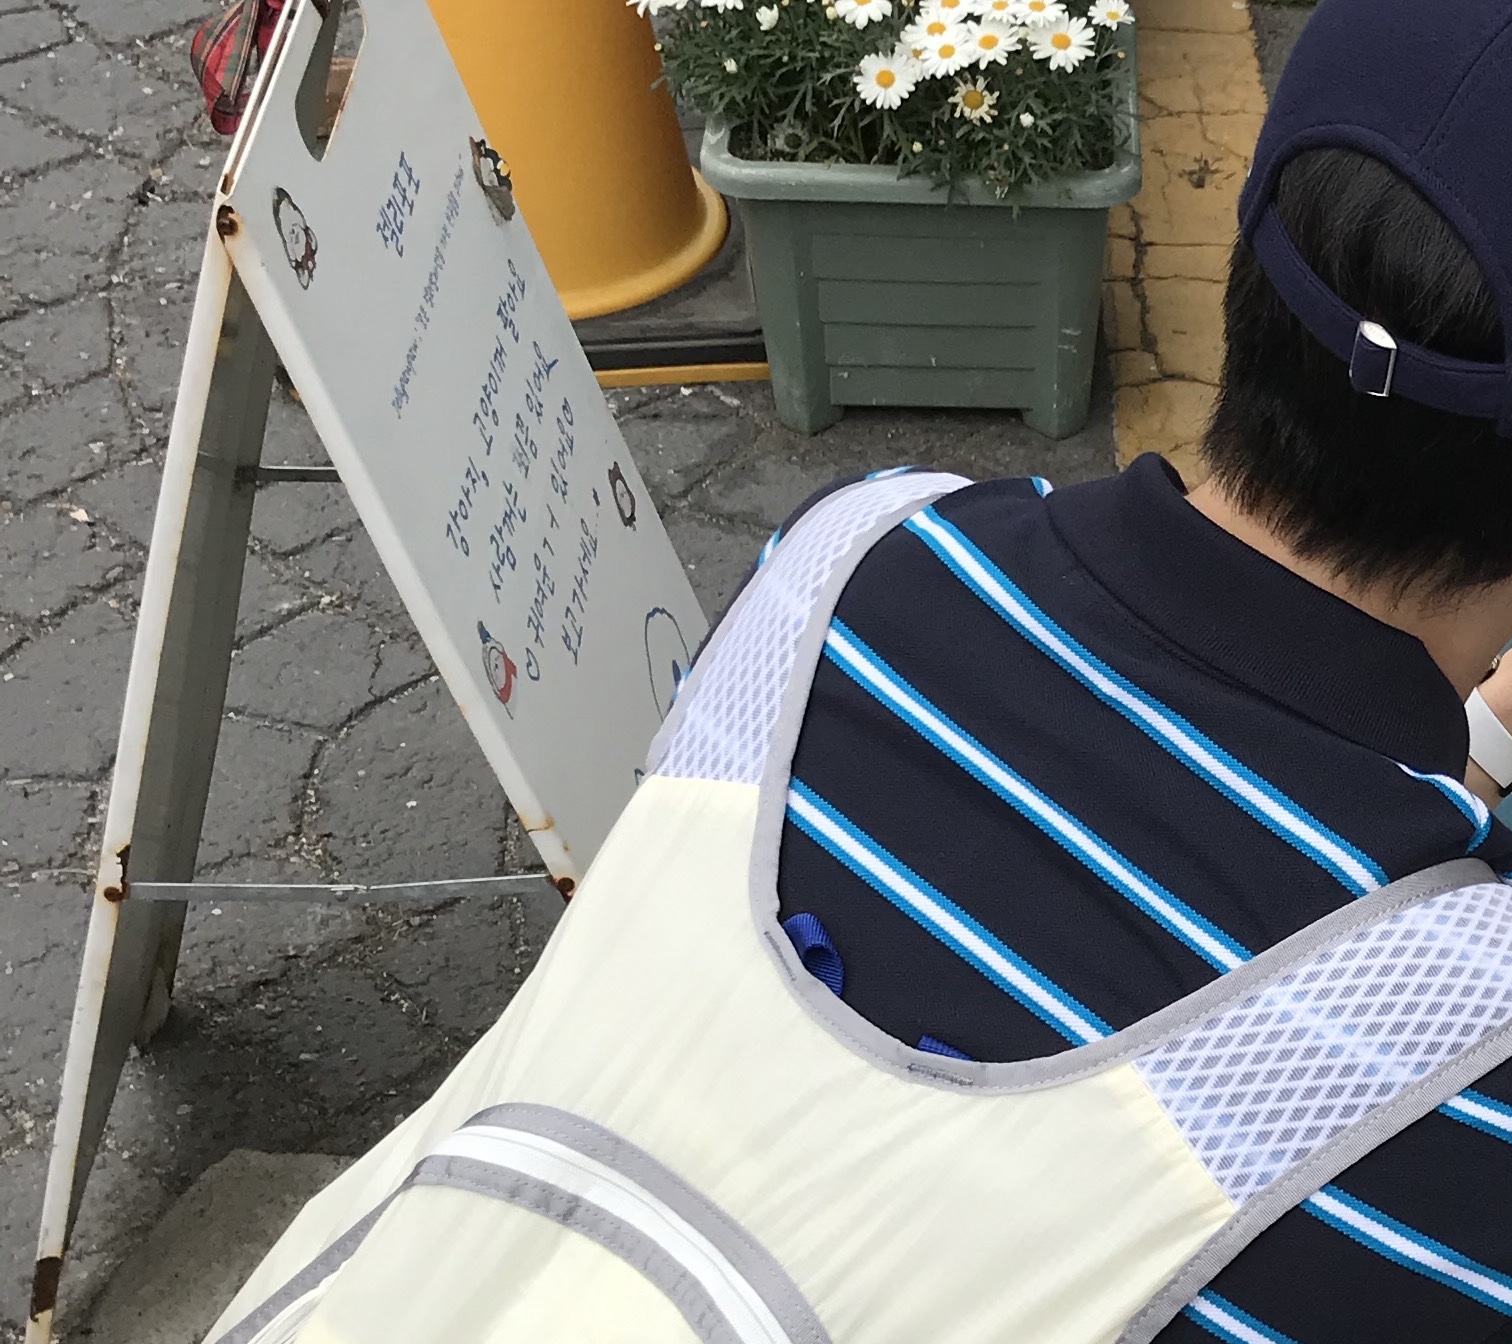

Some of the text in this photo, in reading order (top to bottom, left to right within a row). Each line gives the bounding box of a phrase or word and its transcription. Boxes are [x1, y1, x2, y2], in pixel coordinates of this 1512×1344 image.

[375, 151, 420, 257] 젤리포포
[445, 258, 526, 557] 강아지, 고양이꺼 팔아요
[488, 480, 527, 603] 사람꺼는
[525, 340, 553, 424] 있어요
